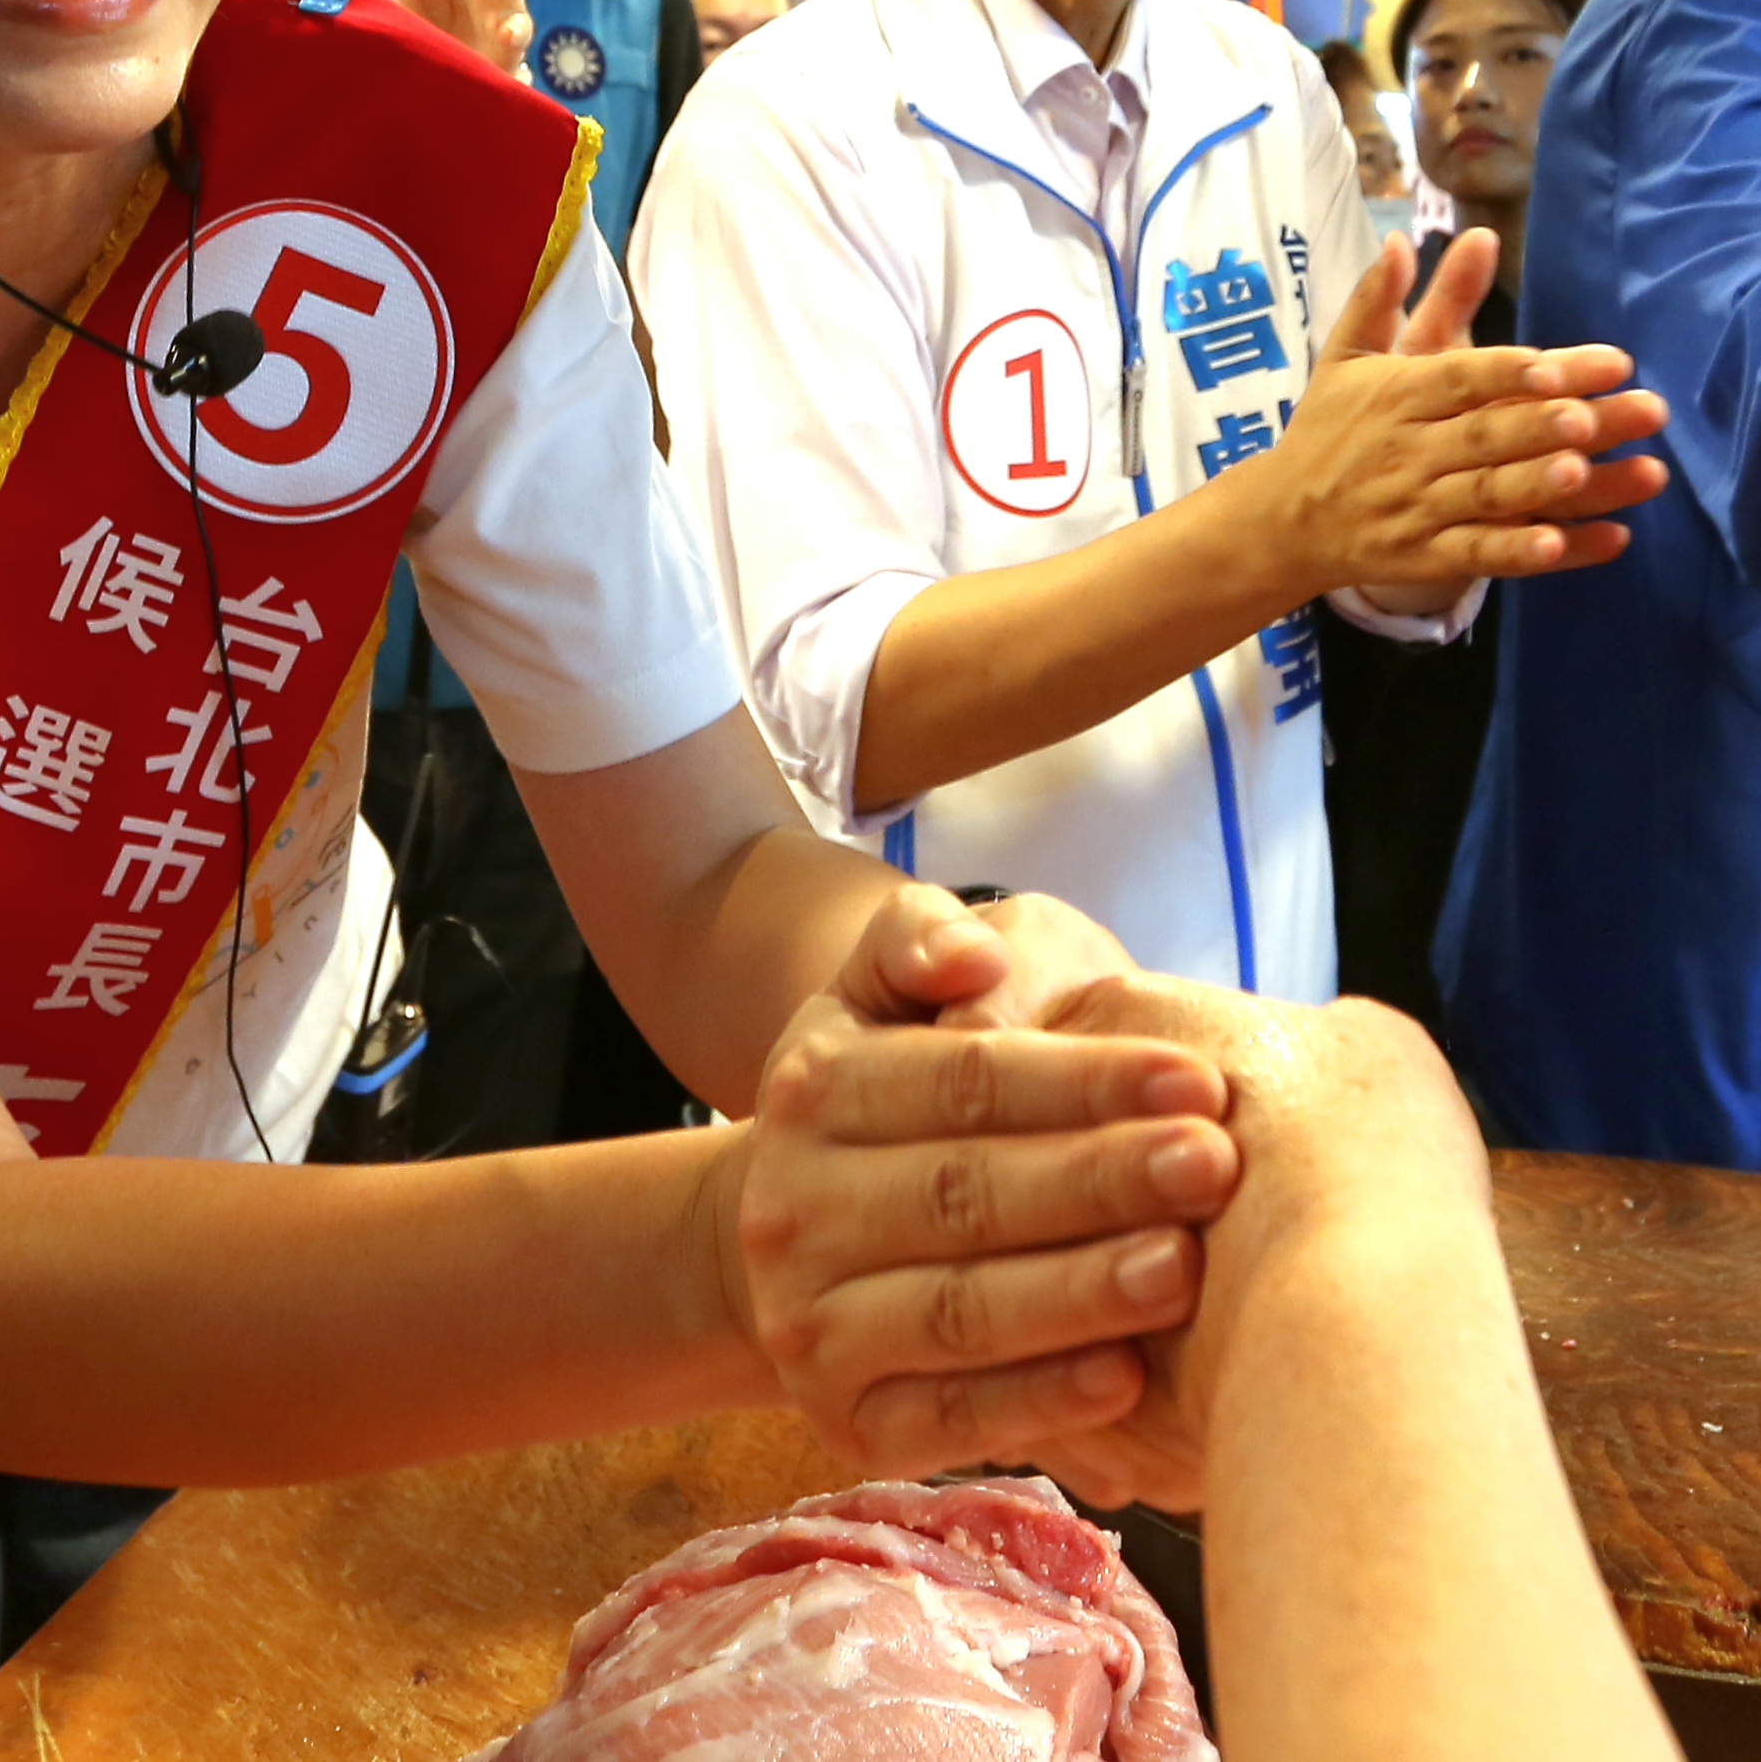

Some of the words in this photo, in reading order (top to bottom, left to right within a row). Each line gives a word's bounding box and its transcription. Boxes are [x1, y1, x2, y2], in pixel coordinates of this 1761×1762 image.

[194, 244, 386, 466] 5
[1003, 346, 1069, 481] 1
[33, 575, 324, 1018] 台北市長
